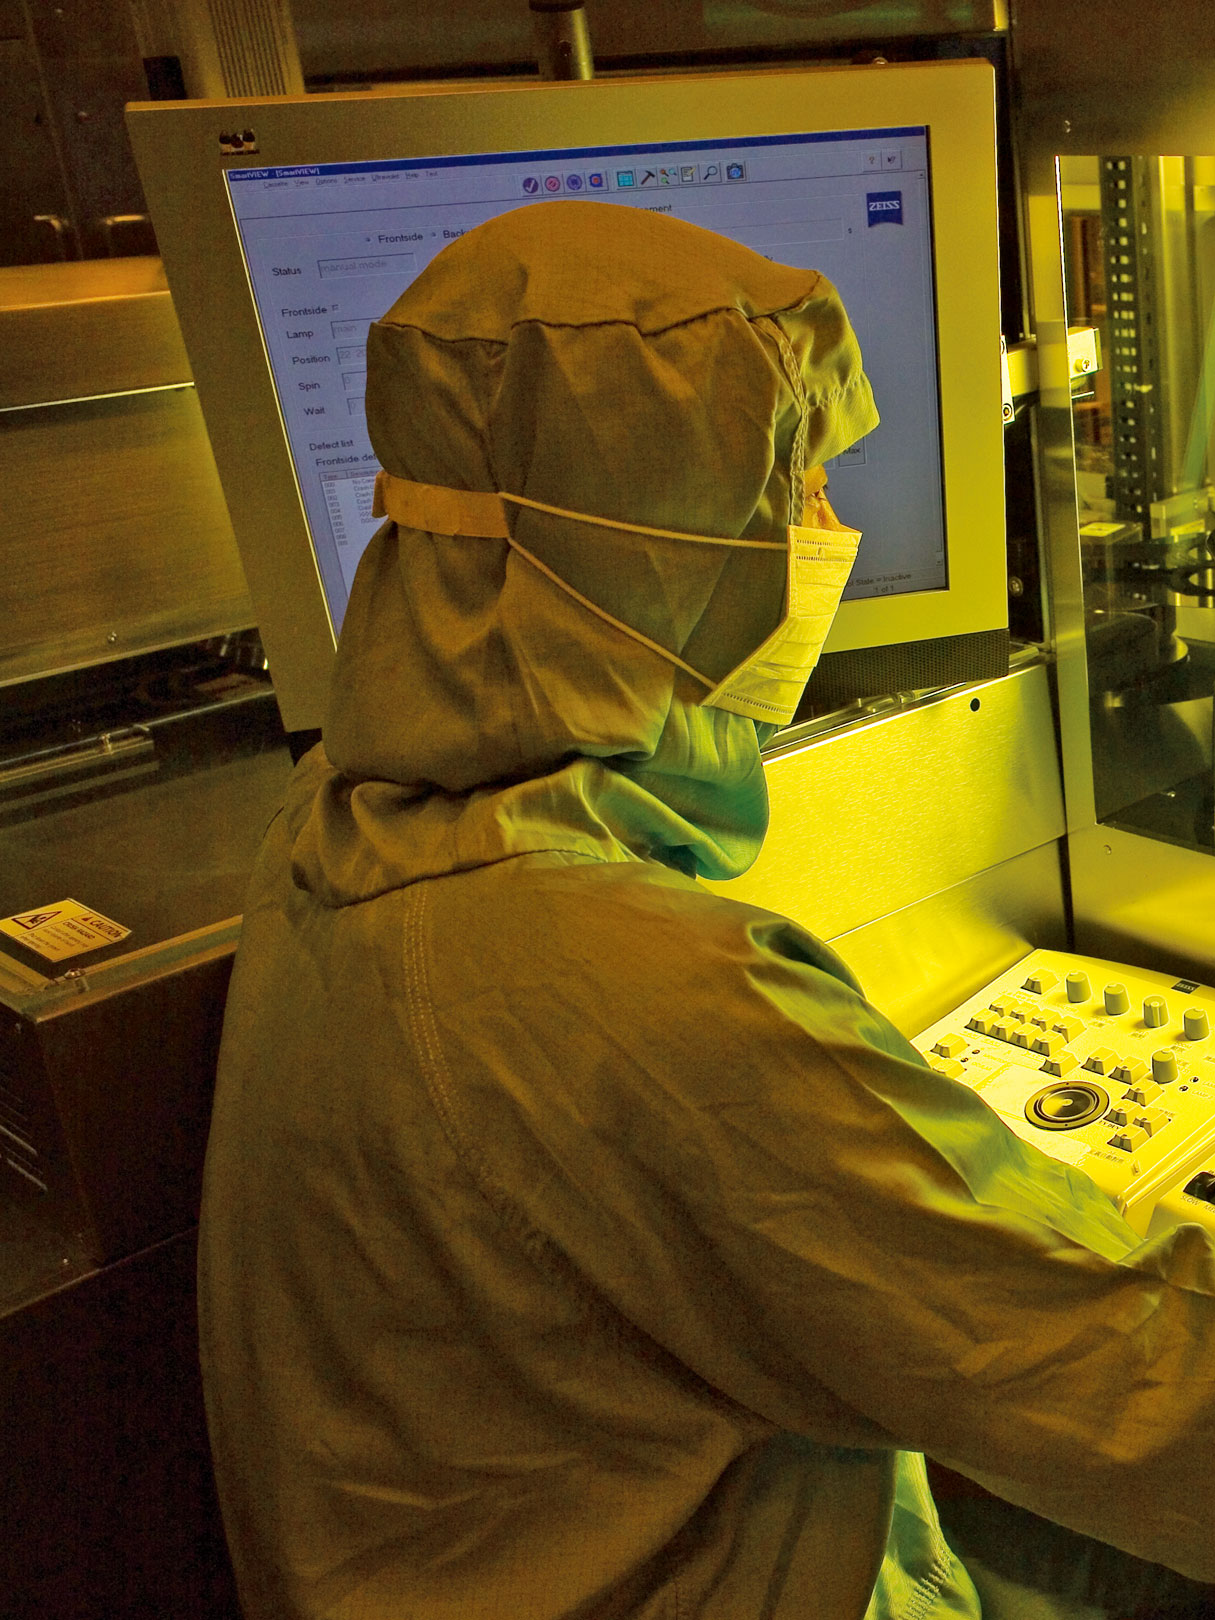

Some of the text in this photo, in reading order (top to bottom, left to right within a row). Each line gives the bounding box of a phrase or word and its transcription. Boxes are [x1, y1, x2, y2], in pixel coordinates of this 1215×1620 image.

[869, 201, 900, 211] ZEISS
[378, 233, 424, 243] Frontside
[272, 267, 302, 277] Status
[281, 306, 327, 317] Frontside
[286, 329, 314, 340] Lamp
[292, 355, 331, 366] Position
[298, 381, 321, 393] Spin
[303, 406, 326, 416] Wait
[309, 439, 354, 451] Defect list
[316, 456, 359, 467] Frontside
[883, 574, 912, 582] Inactive
[1180, 1195, 1200, 1206] SLOW
